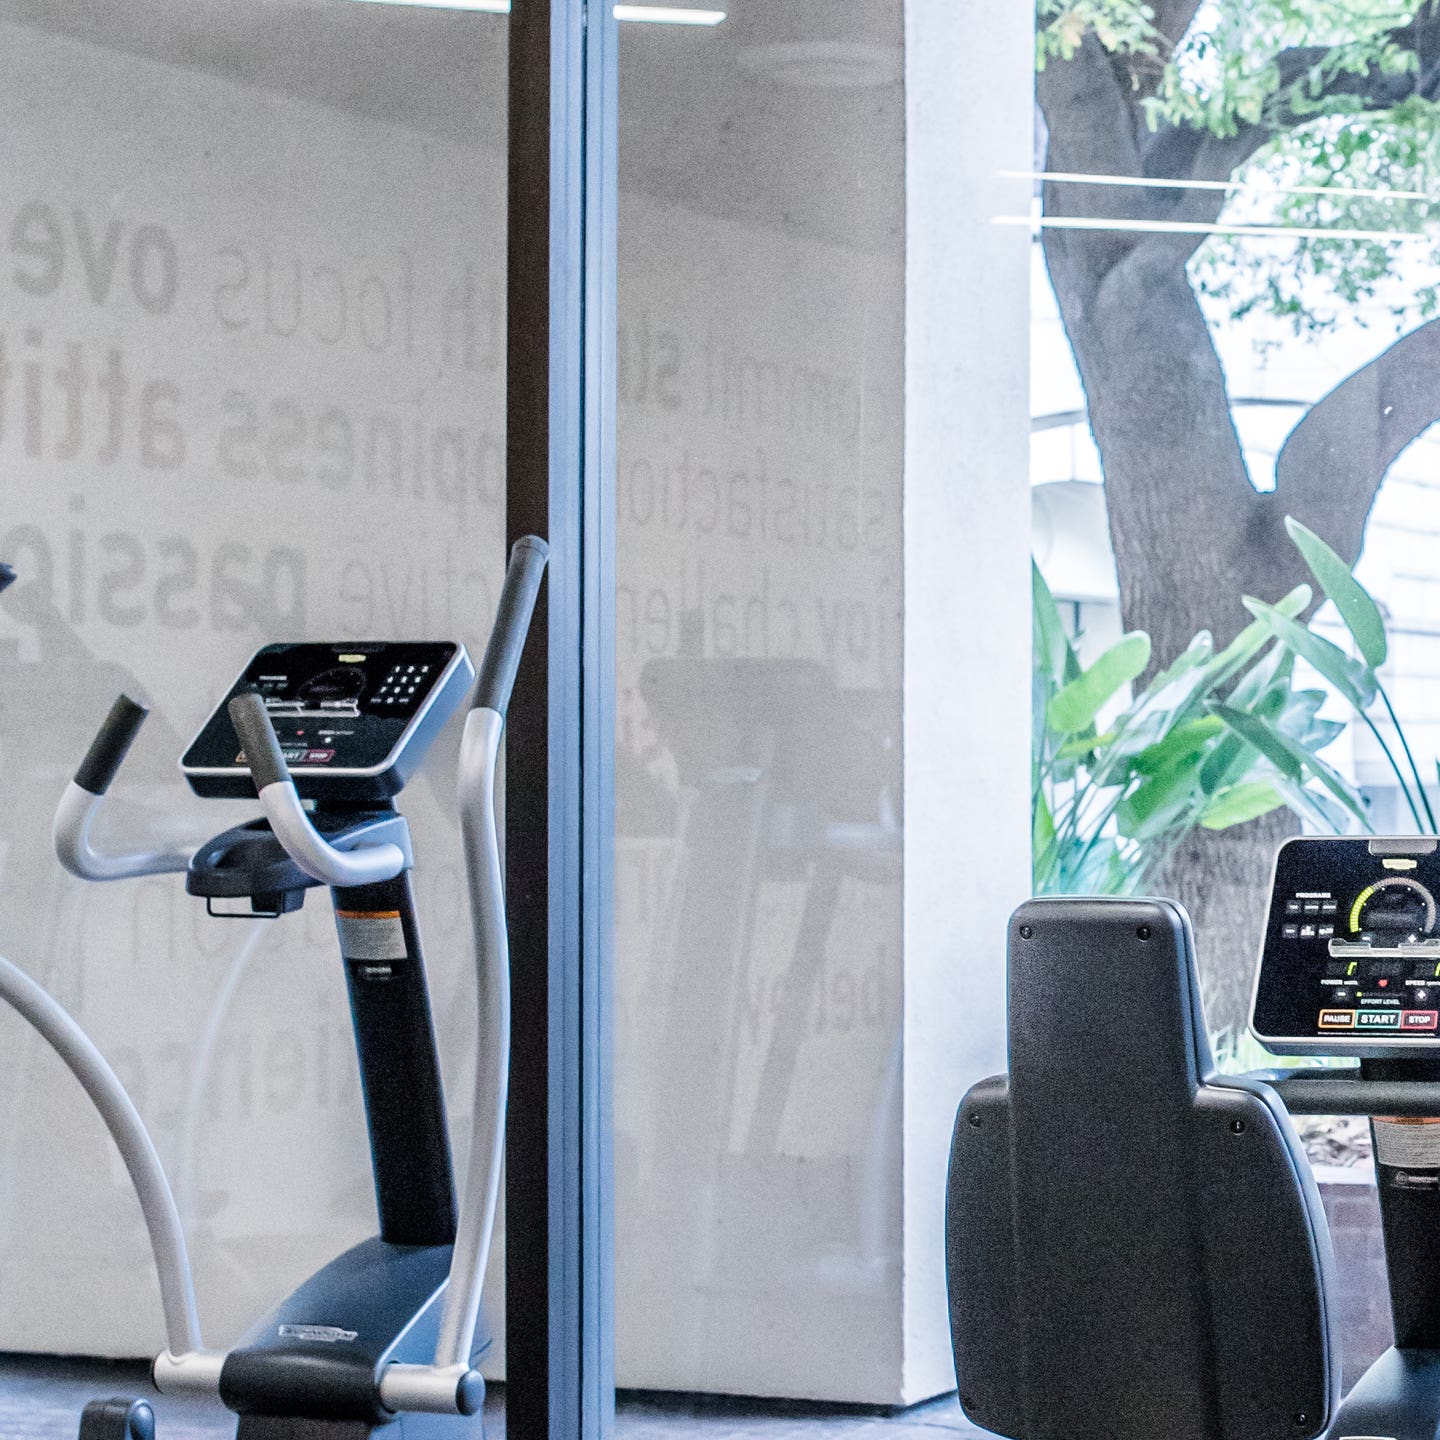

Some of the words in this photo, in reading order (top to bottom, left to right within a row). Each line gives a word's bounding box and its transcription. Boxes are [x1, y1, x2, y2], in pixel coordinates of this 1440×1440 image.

[1323, 1014, 1351, 1023] PAUSE
[1360, 1014, 1396, 1024] START
[1408, 1015, 1431, 1024] STOP
